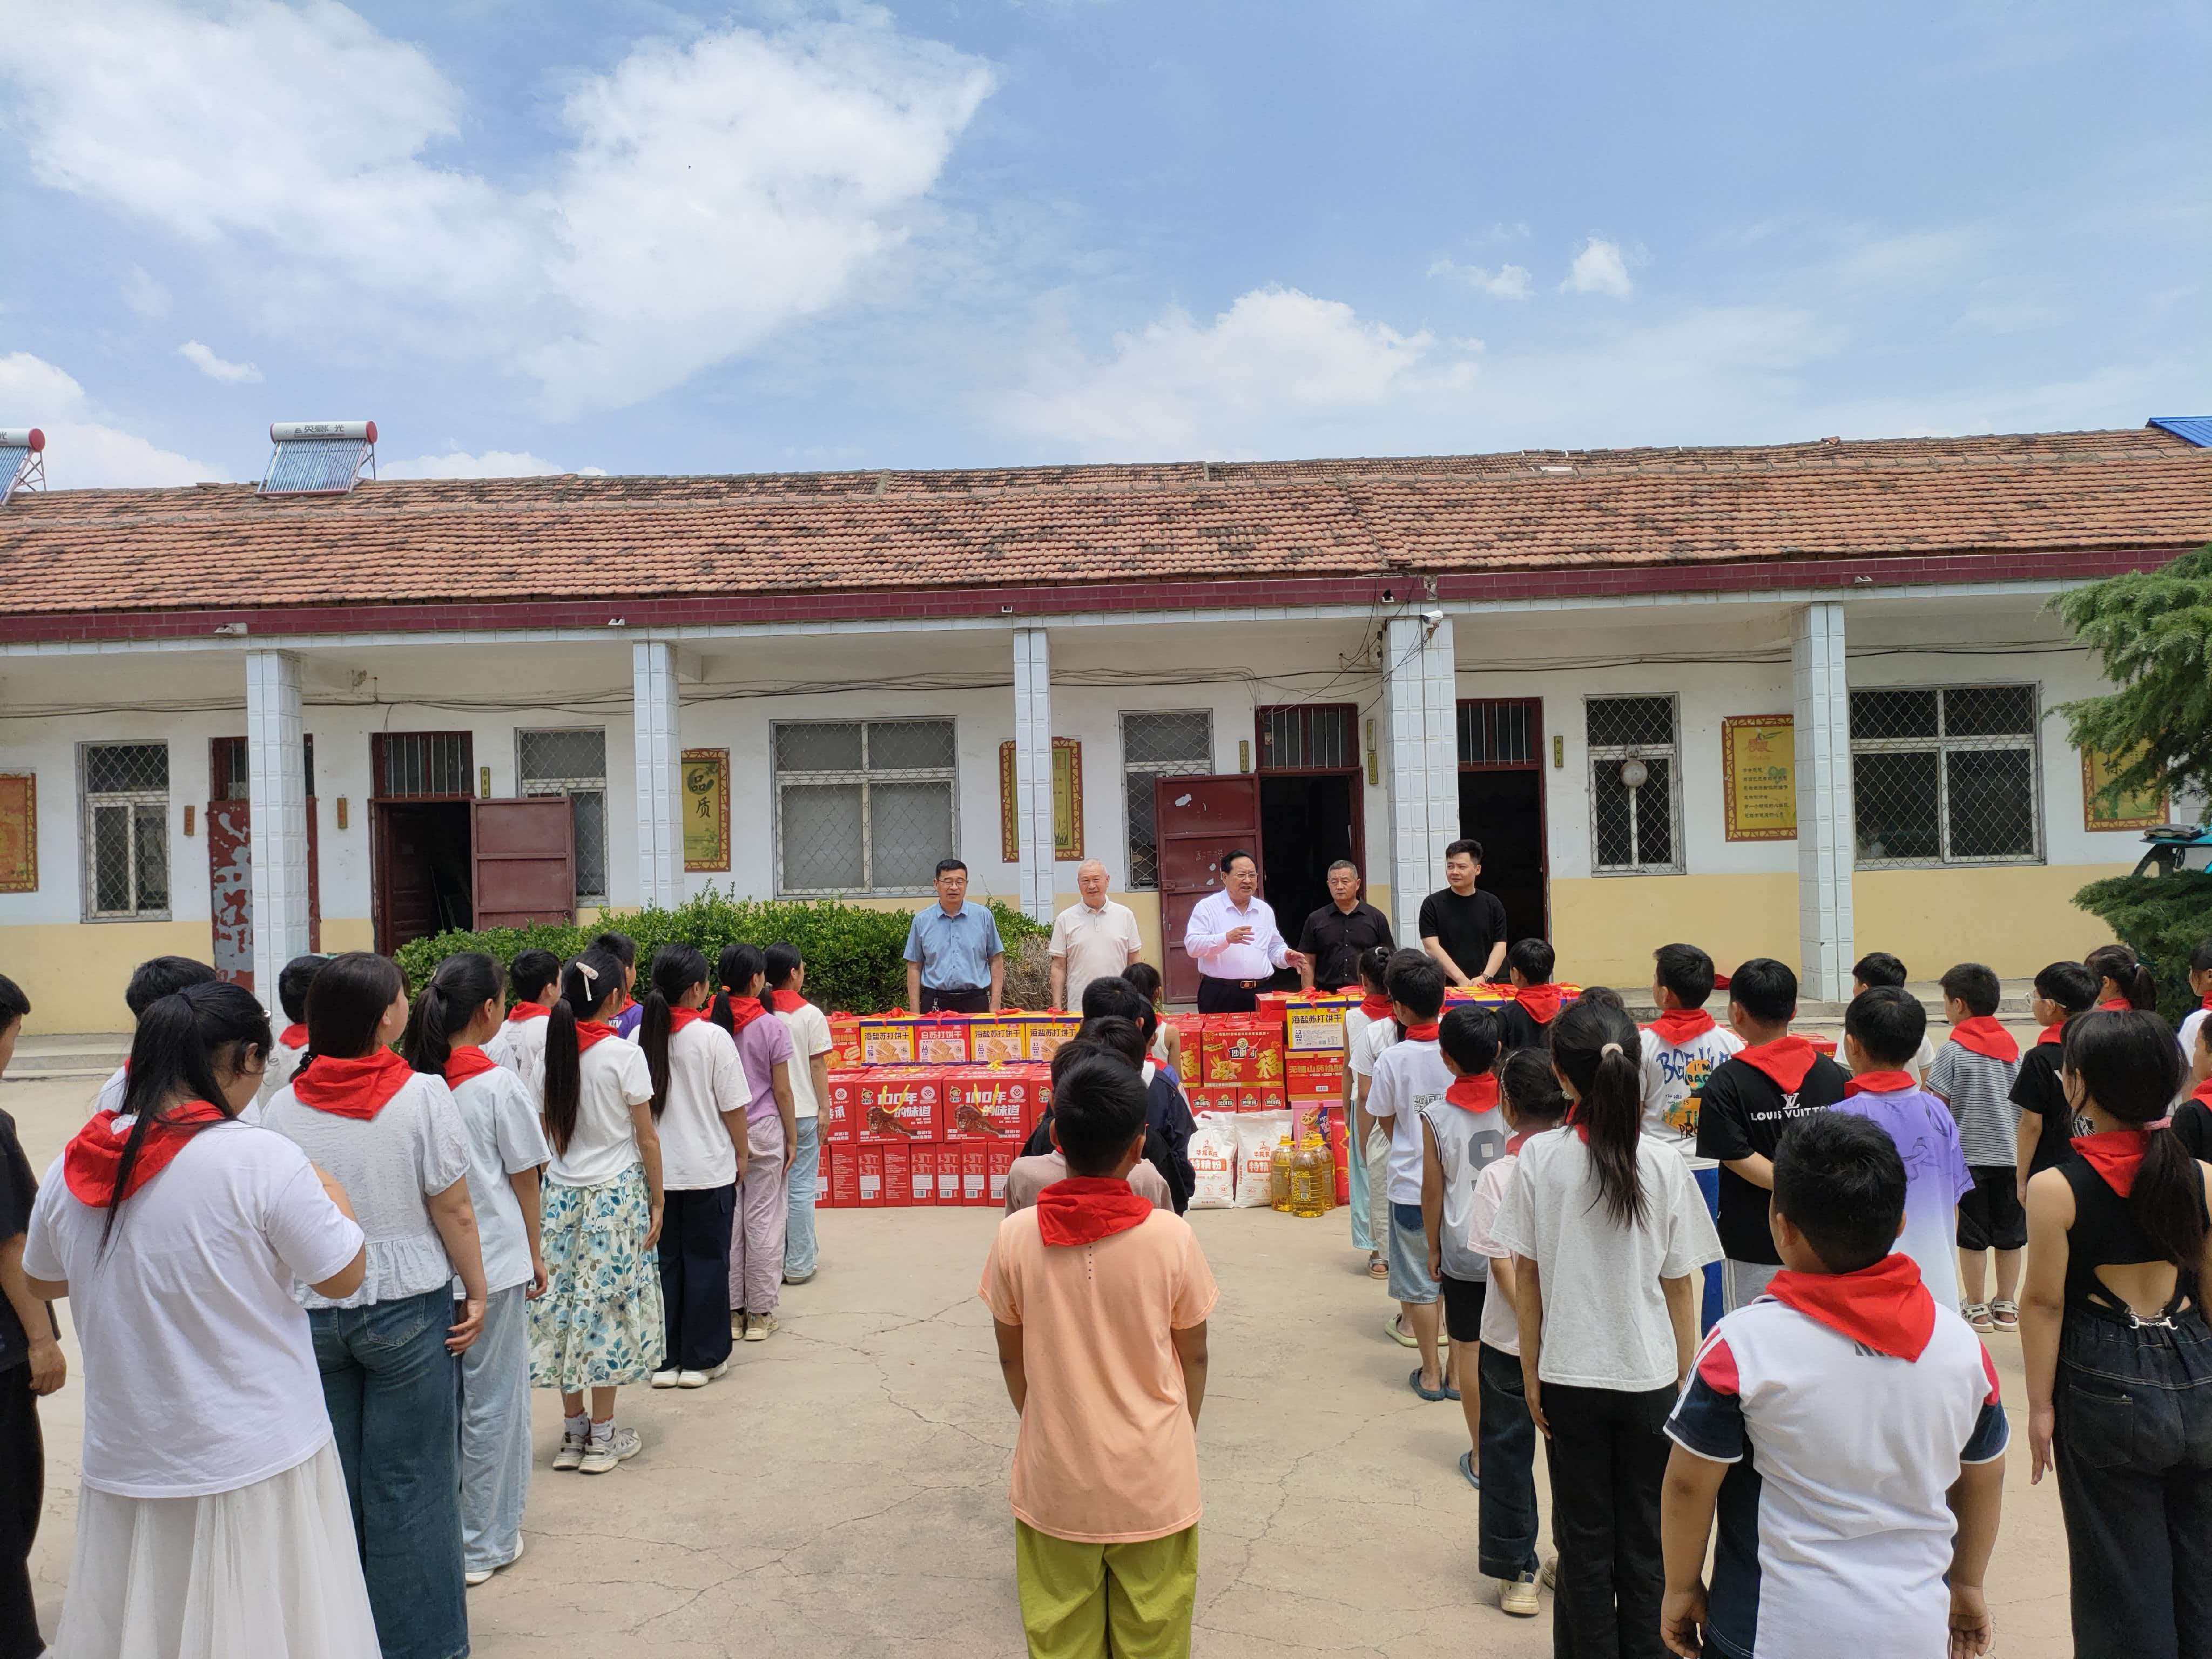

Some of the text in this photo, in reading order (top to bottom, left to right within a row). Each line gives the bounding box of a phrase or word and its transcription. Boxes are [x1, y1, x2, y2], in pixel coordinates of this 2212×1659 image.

[691, 774, 711, 819] 品质
[1292, 1015, 1342, 1024] 海盐苏打饼干
[865, 1032, 909, 1040] 海盐苏打饼干
[975, 1028, 1020, 1037] 海盐苏打饼干
[1030, 1028, 1076, 1037] 海盐苏打饼干
[1750, 1110, 1782, 1121] LOUIS
